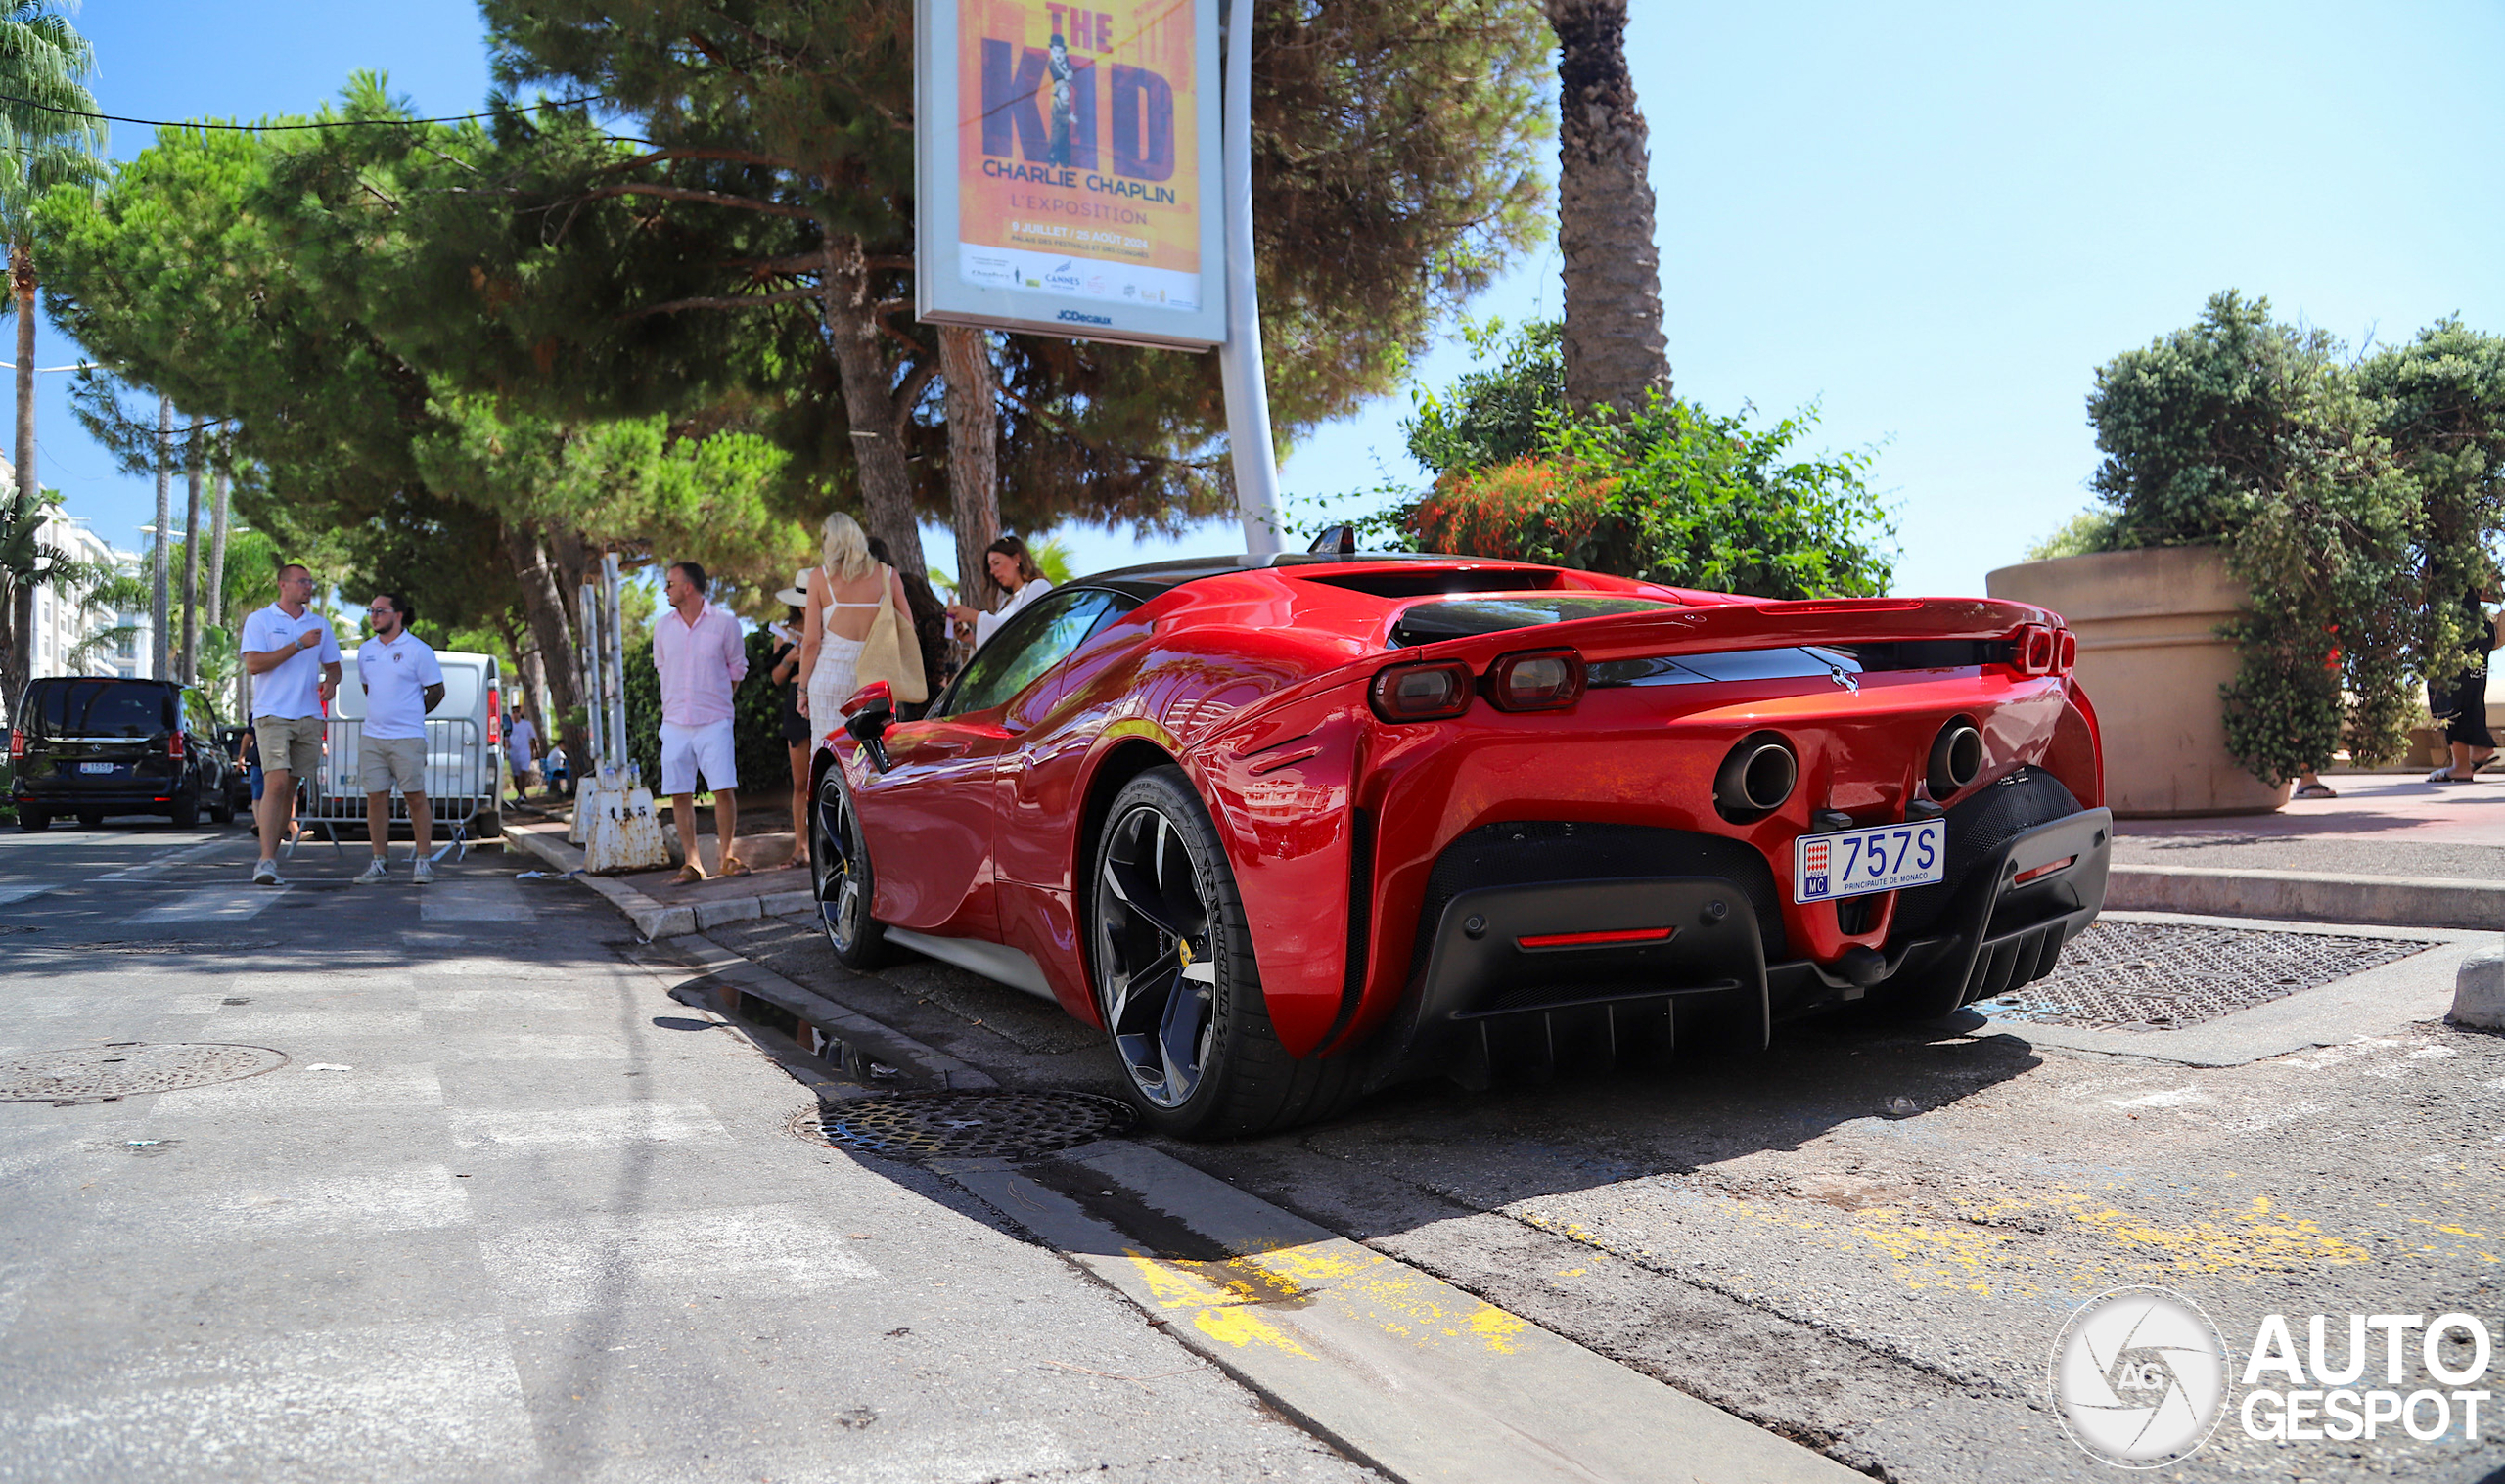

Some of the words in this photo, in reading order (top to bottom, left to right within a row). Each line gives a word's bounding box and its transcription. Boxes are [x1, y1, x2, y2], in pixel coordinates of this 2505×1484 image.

[1045, 1, 1114, 54] THE
[981, 37, 1175, 183] KID
[982, 159, 1077, 188] CHARLIE
[1085, 174, 1175, 204] CHAPLIN
[1011, 193, 1148, 225] L'EXPOSITION
[1011, 221, 1020, 232] 9
[1021, 223, 1068, 238] JUILLET
[1076, 230, 1090, 241] 25
[1091, 231, 1122, 245] AOÛT
[1123, 237, 1149, 248] 2024
[1044, 274, 1081, 286] CANNES
[1057, 309, 1113, 325] JCDecaux
[1842, 828, 1936, 882] 757S
[1808, 877, 1825, 894] MC
[1845, 877, 1888, 891] PRINCIPAUTE
[1890, 876, 1898, 885] DE
[1899, 872, 1929, 883] MONACO
[1215, 922, 1229, 1018] MICHELIN
